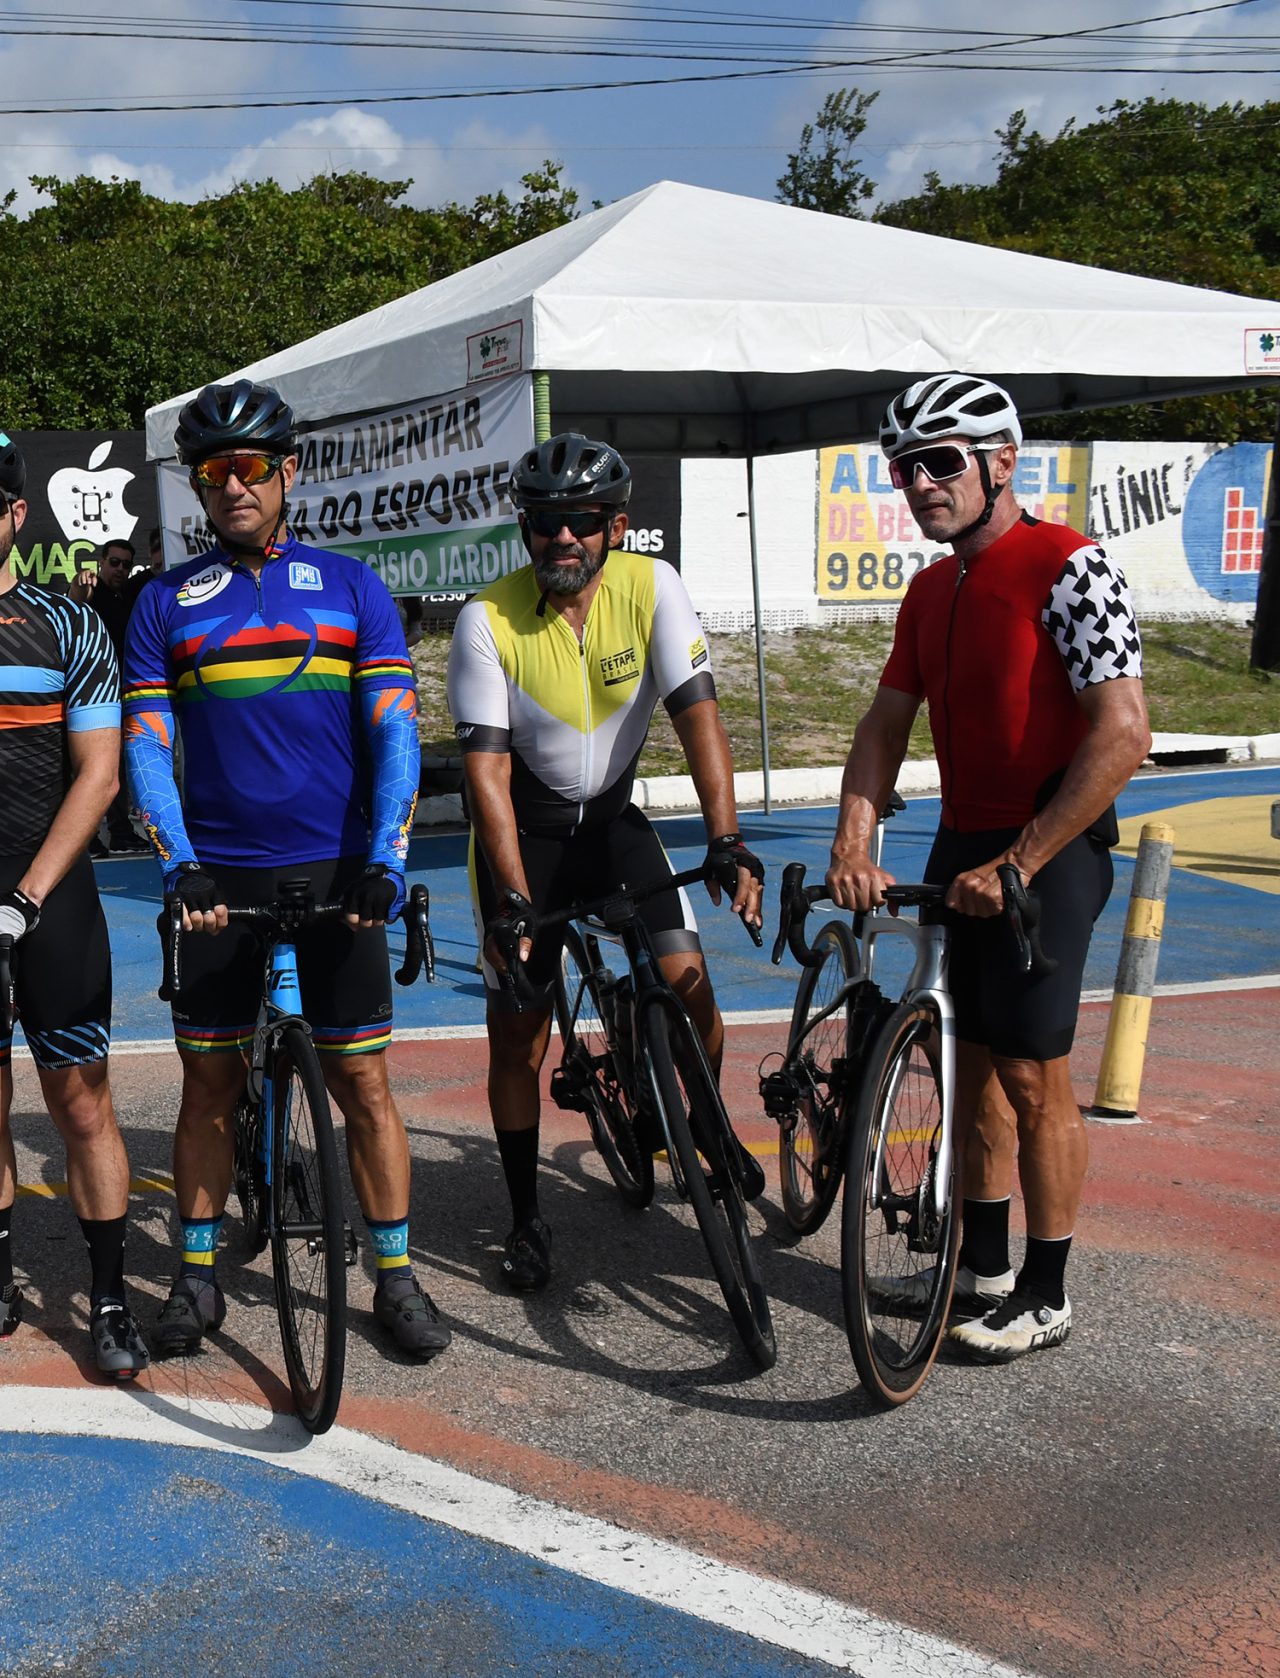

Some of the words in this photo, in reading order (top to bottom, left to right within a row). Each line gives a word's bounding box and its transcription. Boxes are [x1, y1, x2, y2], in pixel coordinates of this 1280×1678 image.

[319, 490, 362, 538] DO
[372, 460, 513, 532] ESPORTE
[828, 504, 866, 542] DE
[436, 539, 532, 585] JARDIM
